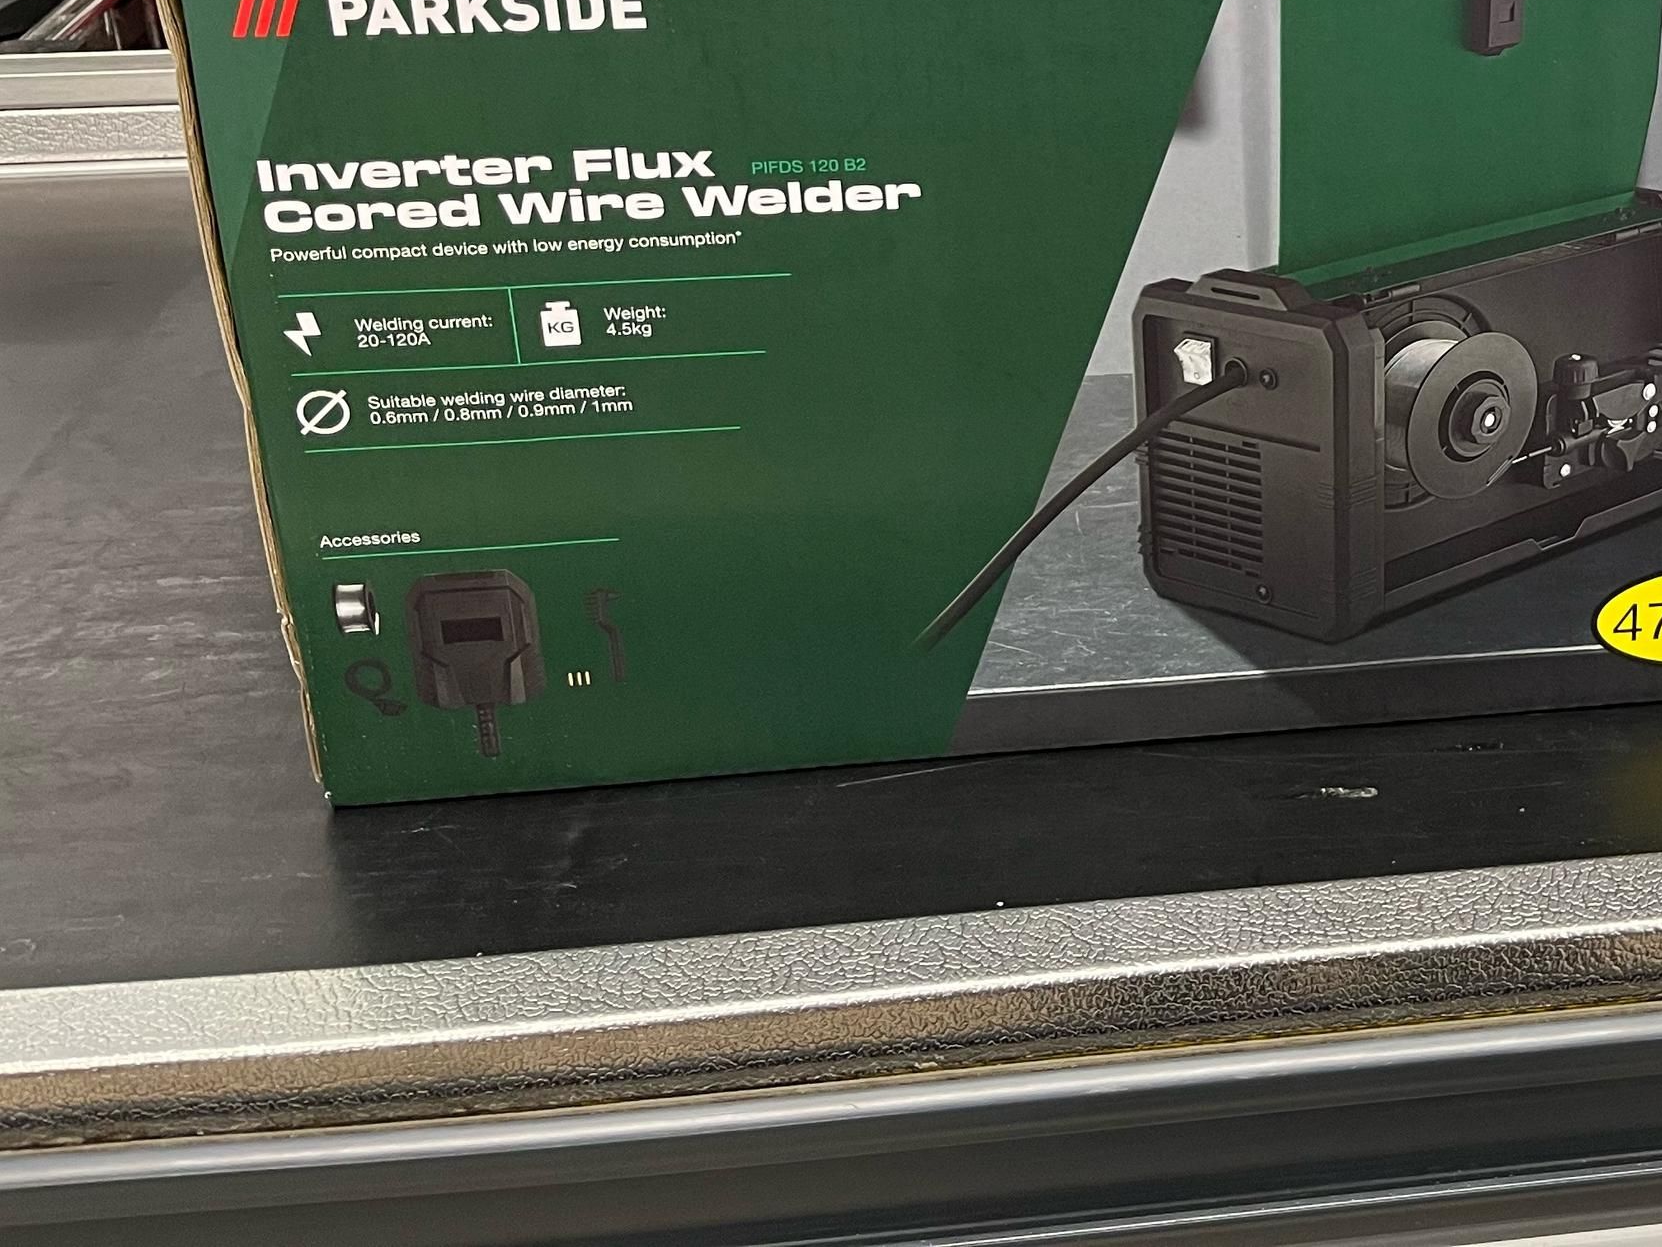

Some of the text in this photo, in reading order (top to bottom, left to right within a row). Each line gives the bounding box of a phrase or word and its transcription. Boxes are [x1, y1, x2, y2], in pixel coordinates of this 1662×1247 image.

[256, 146, 866, 192] Inverter Flux PIFDS 120 B2
[264, 180, 922, 234] Cored Wire Welder
[270, 246, 347, 262] Powerful
[351, 244, 428, 261] compact
[432, 241, 488, 257] device
[492, 239, 529, 254] with
[533, 238, 563, 252] low
[567, 237, 624, 252] energy
[354, 314, 493, 334] Welding current:
[603, 306, 667, 324] Weight:
[546, 320, 575, 335] KG
[605, 321, 653, 339] 4.5kg
[357, 332, 432, 349] 20-120A
[368, 384, 626, 410] Suitable welding wire diameter:
[369, 398, 633, 425] 0.6mm 0.8mm 0.9mm 1mm
[319, 530, 422, 549] Accessories
